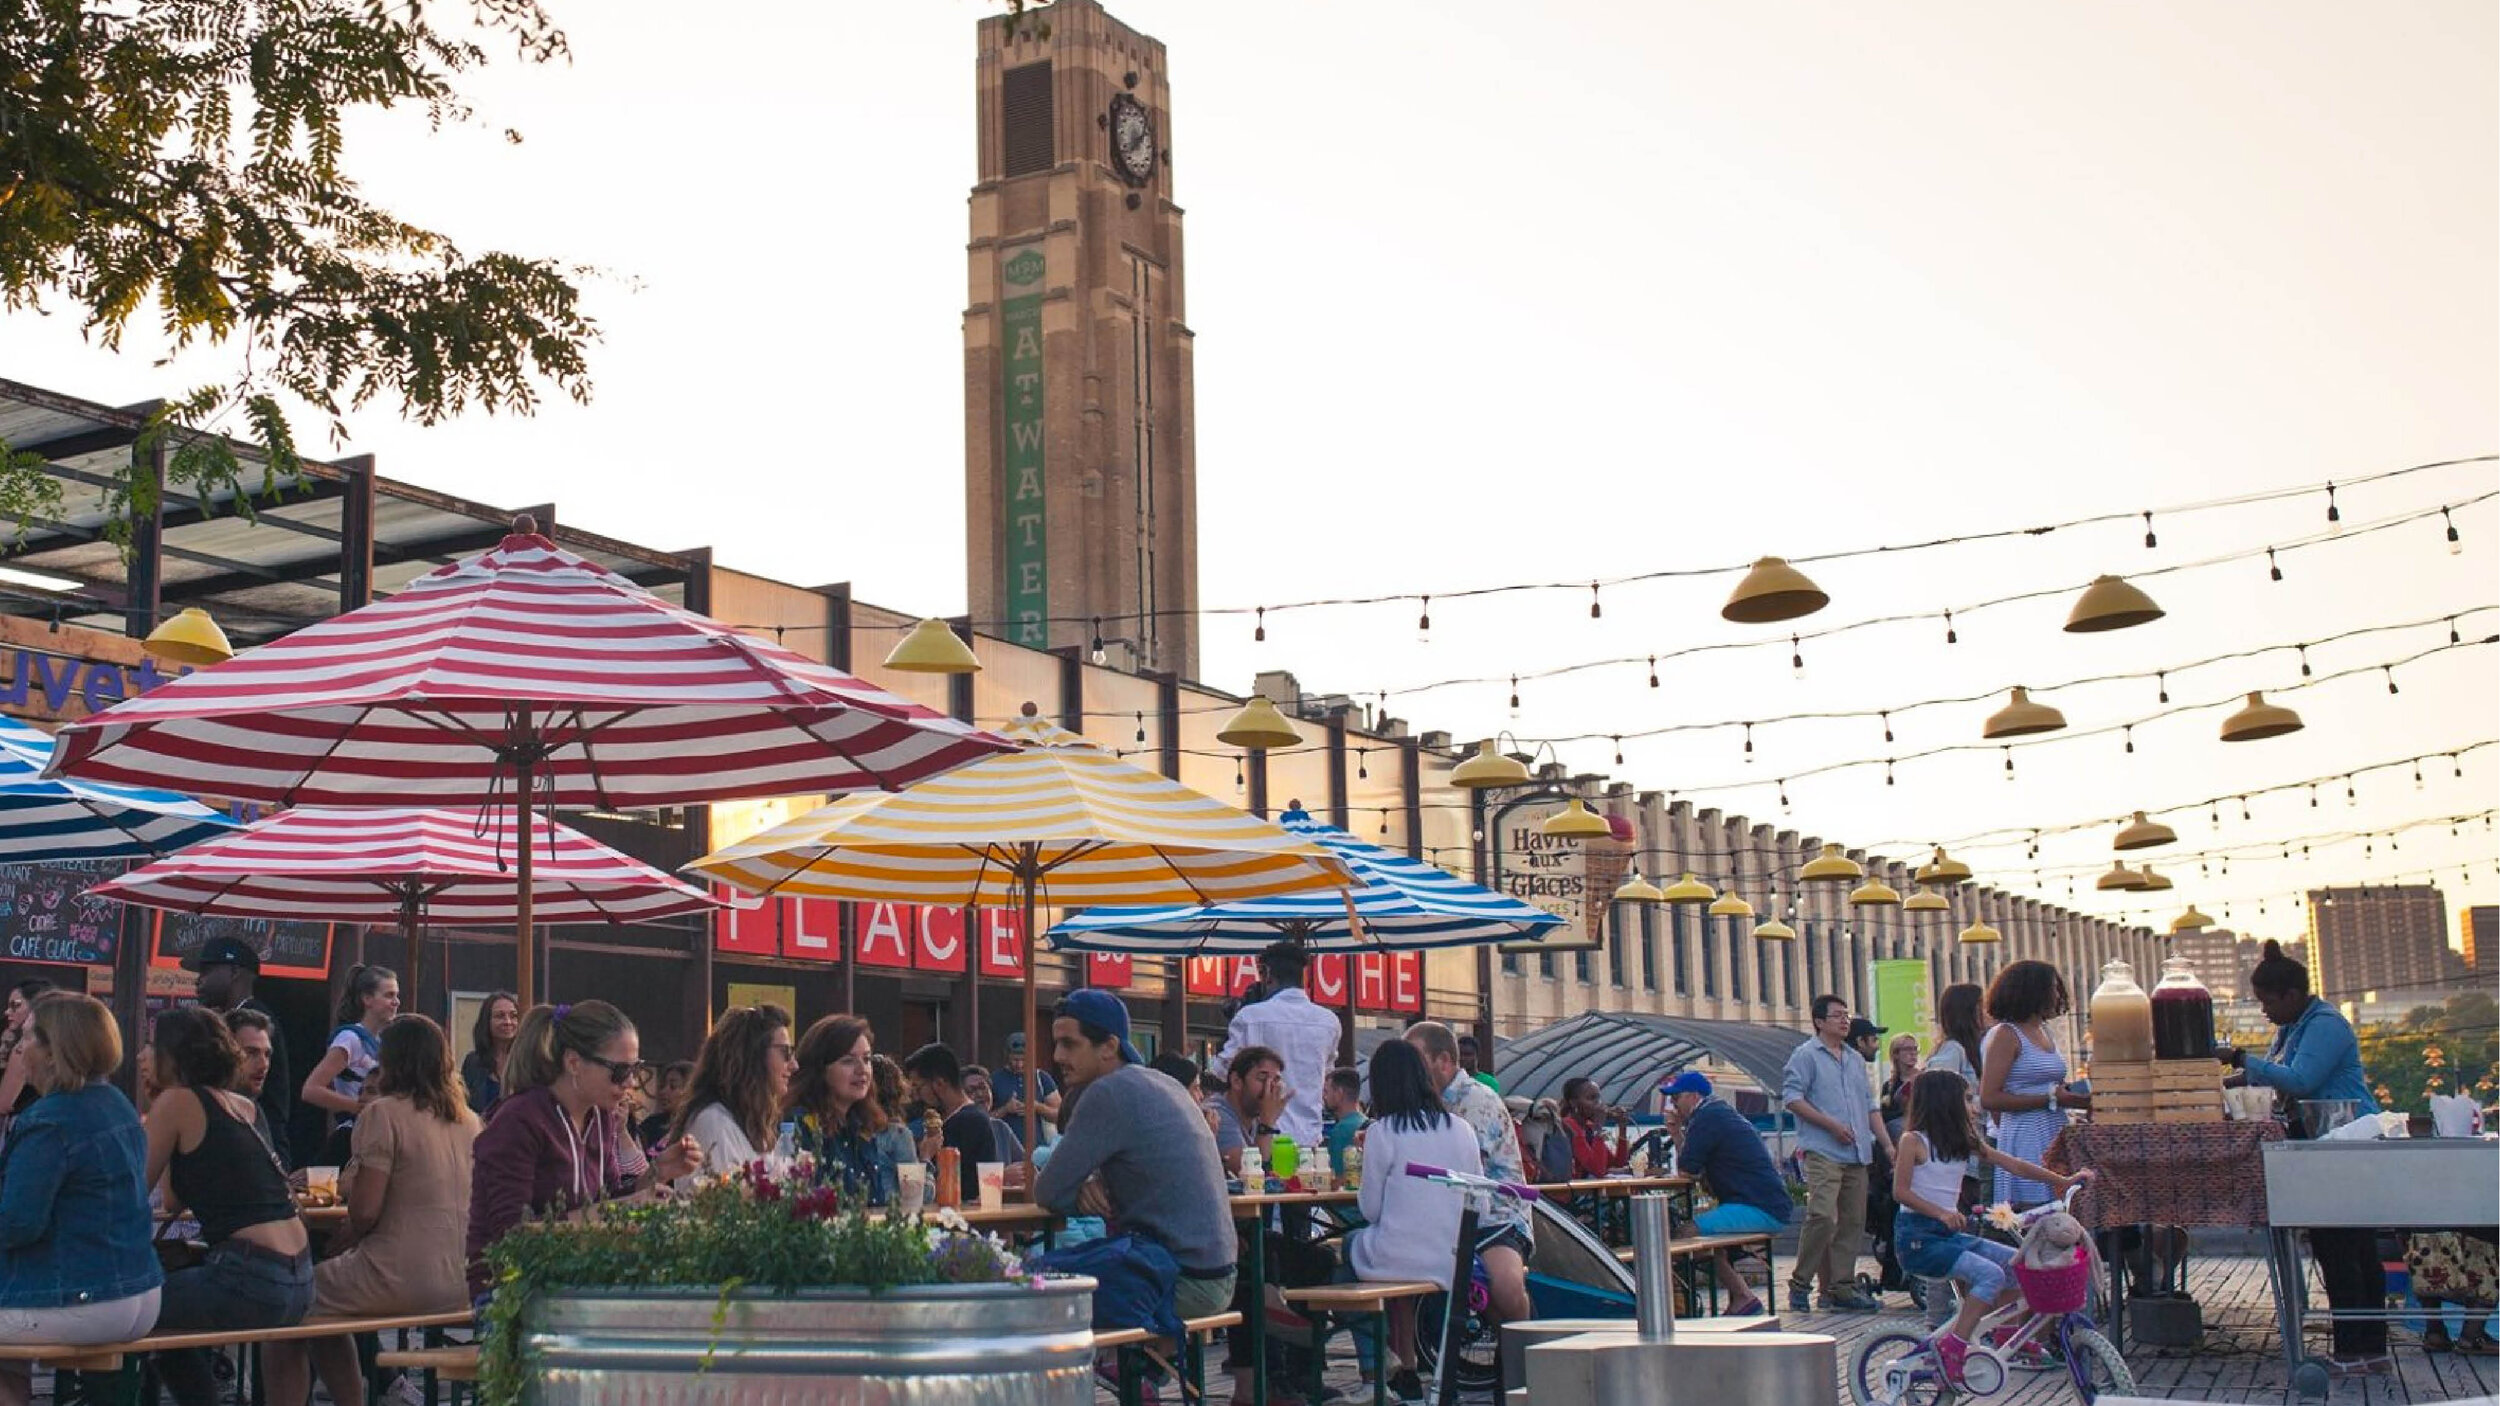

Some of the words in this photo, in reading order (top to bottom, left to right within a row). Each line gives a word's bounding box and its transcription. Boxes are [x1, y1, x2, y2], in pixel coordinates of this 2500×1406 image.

[1012, 326, 1043, 643] ATWATER
[729, 886, 1018, 966] PLACE
[1512, 874, 1583, 898] Glaces
